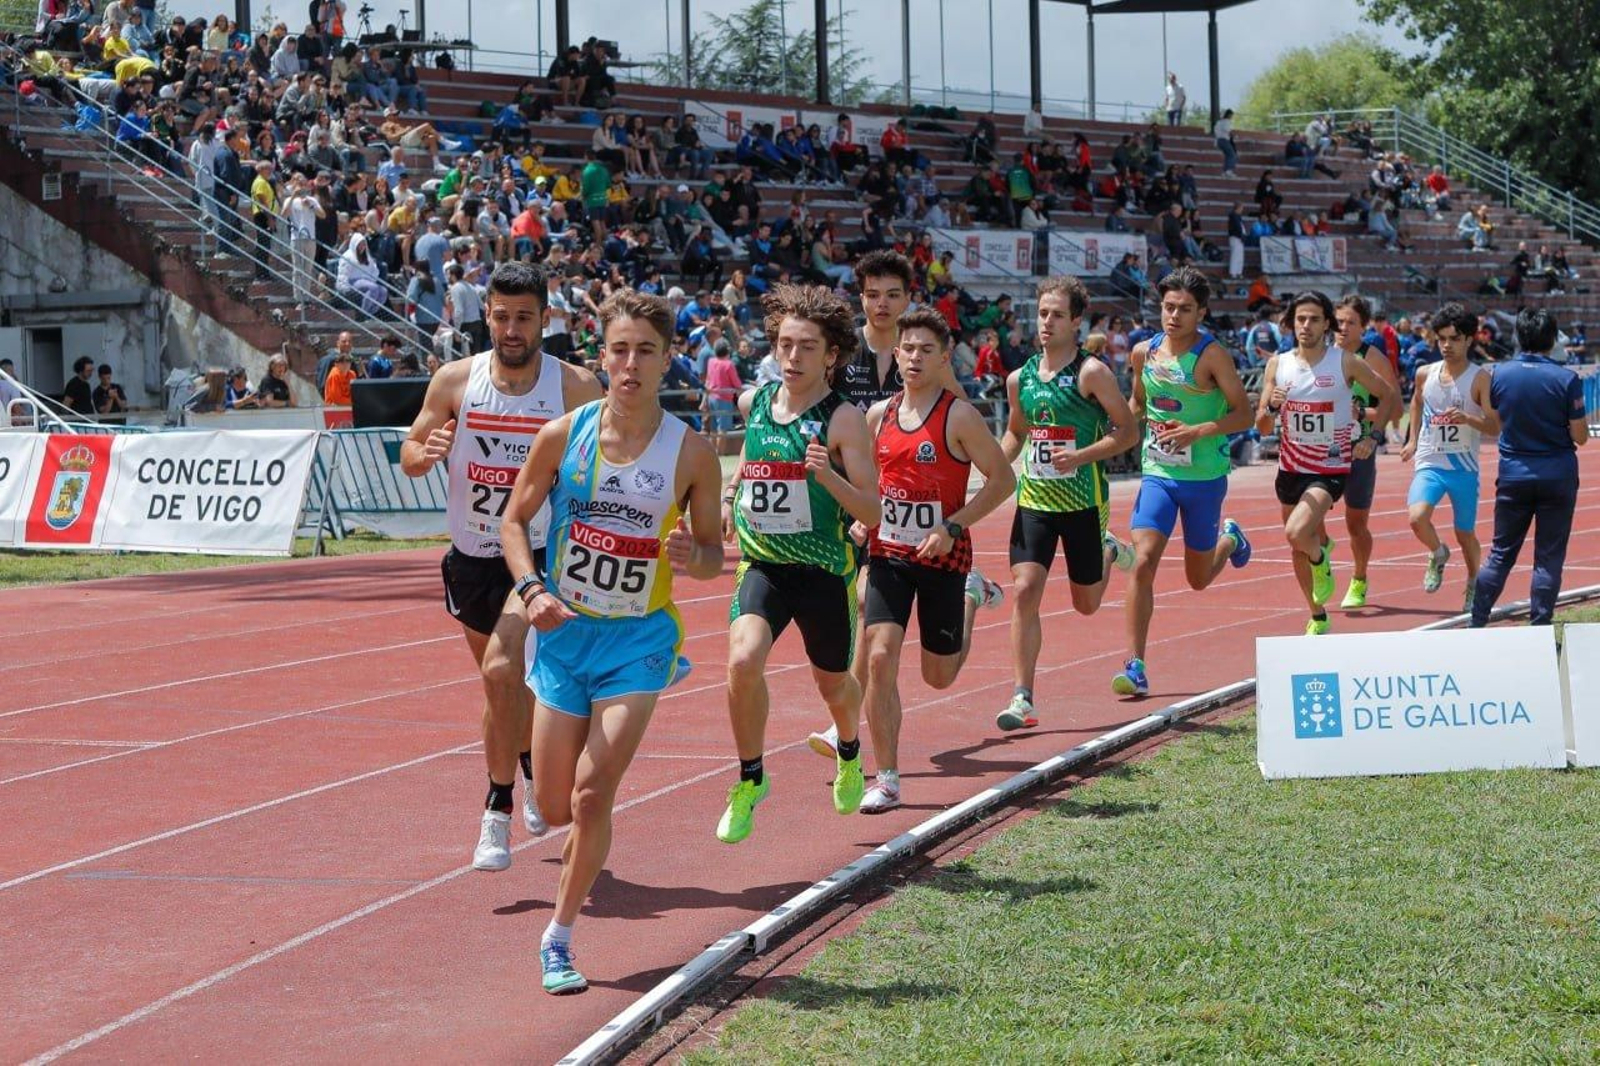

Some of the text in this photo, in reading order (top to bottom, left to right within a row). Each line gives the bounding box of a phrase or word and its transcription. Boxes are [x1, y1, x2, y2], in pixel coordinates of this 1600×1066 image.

[1287, 402, 1310, 412] VIGO
[1293, 413, 1324, 433] 161
[1438, 425, 1460, 442] 12
[762, 436, 790, 448] LUCUS
[1033, 441, 1066, 464] 16
[507, 454, 527, 463] FOO
[742, 464, 771, 478] VIGO
[137, 458, 286, 486] CONCELLO
[470, 463, 508, 484] VIGO
[472, 483, 513, 517] 27
[751, 481, 791, 513] 82
[883, 485, 907, 499] VIGO
[147, 494, 262, 522] DE VIGO
[569, 498, 653, 529] Quescrem
[884, 499, 934, 529] 370
[573, 523, 616, 551] VIGO
[615, 539, 657, 556] 2024
[566, 544, 649, 594] 205
[1352, 674, 1461, 700] XUNTA
[1354, 701, 1531, 730] DE GALICIA
